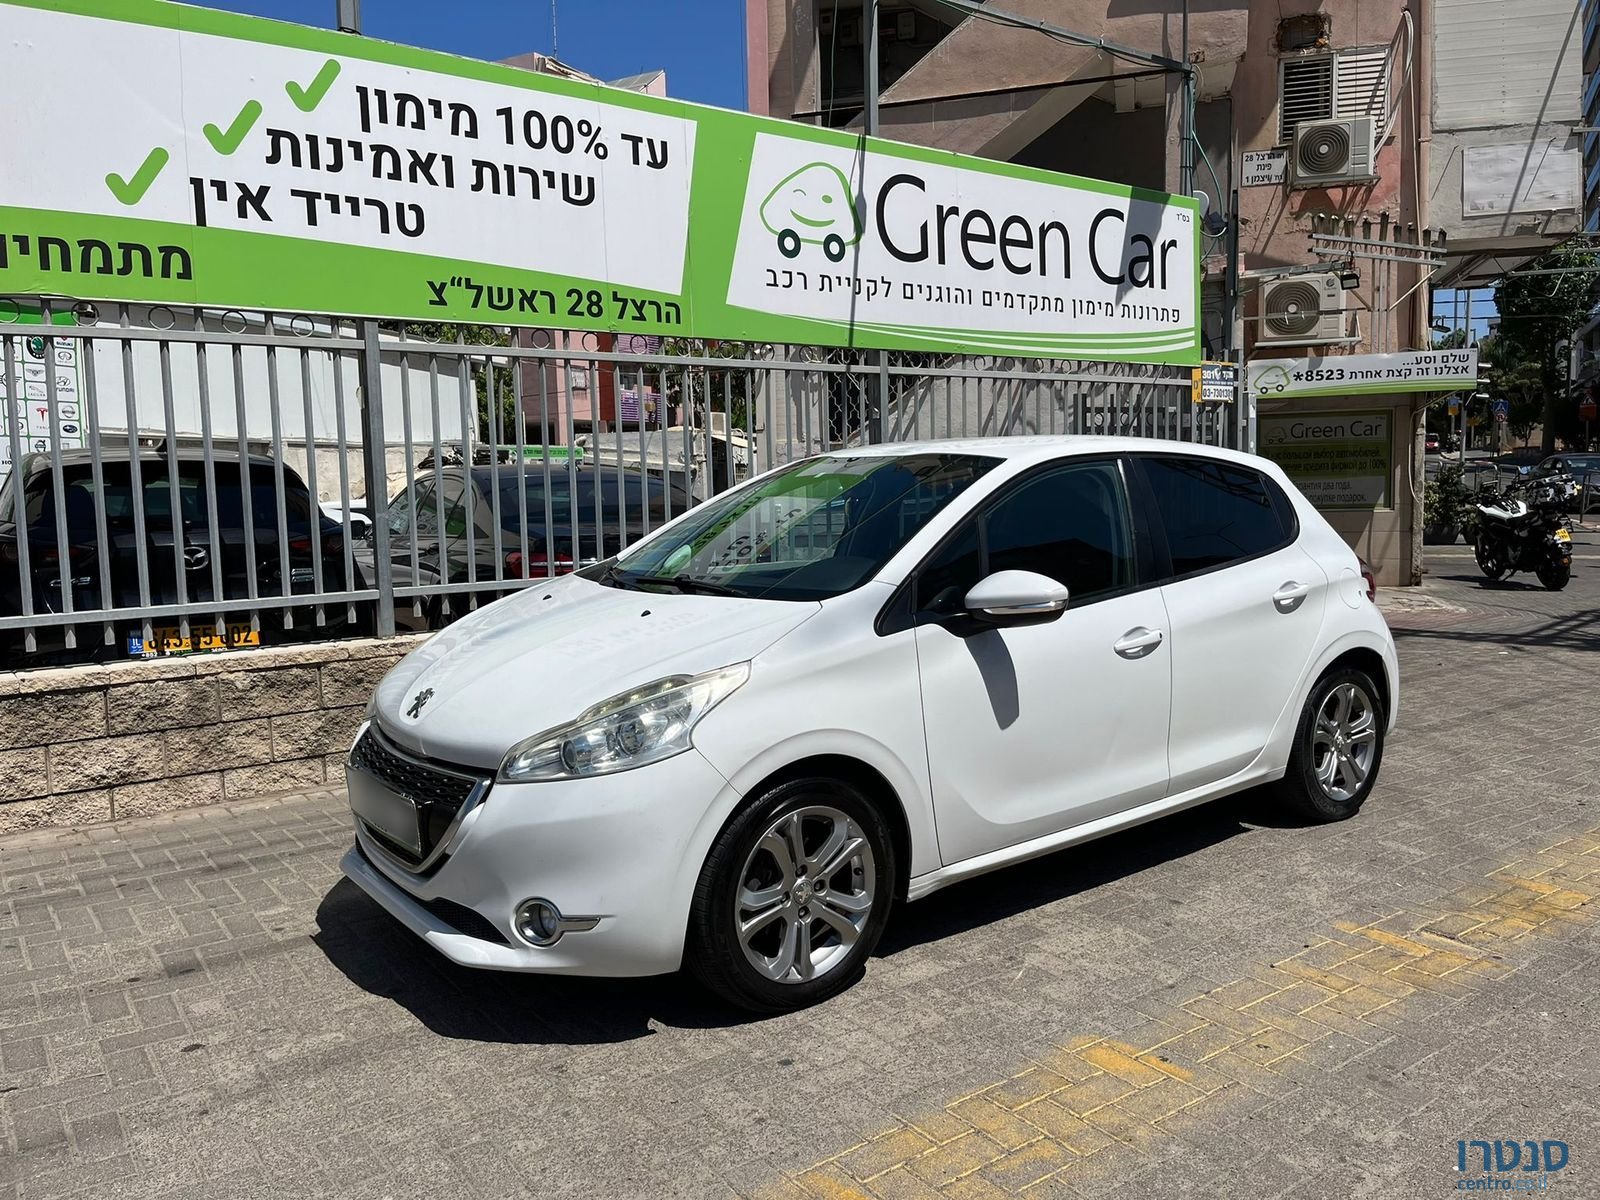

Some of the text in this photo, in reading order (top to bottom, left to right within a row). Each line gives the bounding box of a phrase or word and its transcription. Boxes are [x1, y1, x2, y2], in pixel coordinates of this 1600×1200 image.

[355, 85, 669, 170] עד 100% מימון
[1244, 154, 1254, 162] 28
[265, 127, 596, 207] שירות ואמינות
[1256, 163, 1272, 171] פינת
[1245, 175, 1249, 183] 1
[189, 176, 426, 238] טרייד אין
[876, 173, 1178, 290] Green Car
[565, 288, 604, 318] 28
[766, 268, 1180, 323] פתרונות מימון מתקדמים והוגנים לקניית רכב
[612, 290, 682, 325] הרצל
[1402, 352, 1470, 366] שלם וסע...
[1348, 369, 1383, 380] אחרת
[1386, 367, 1412, 379] קצת
[1416, 367, 1431, 376] זה
[1434, 364, 1470, 376] אצלנו
[1290, 420, 1383, 440] Green Car
